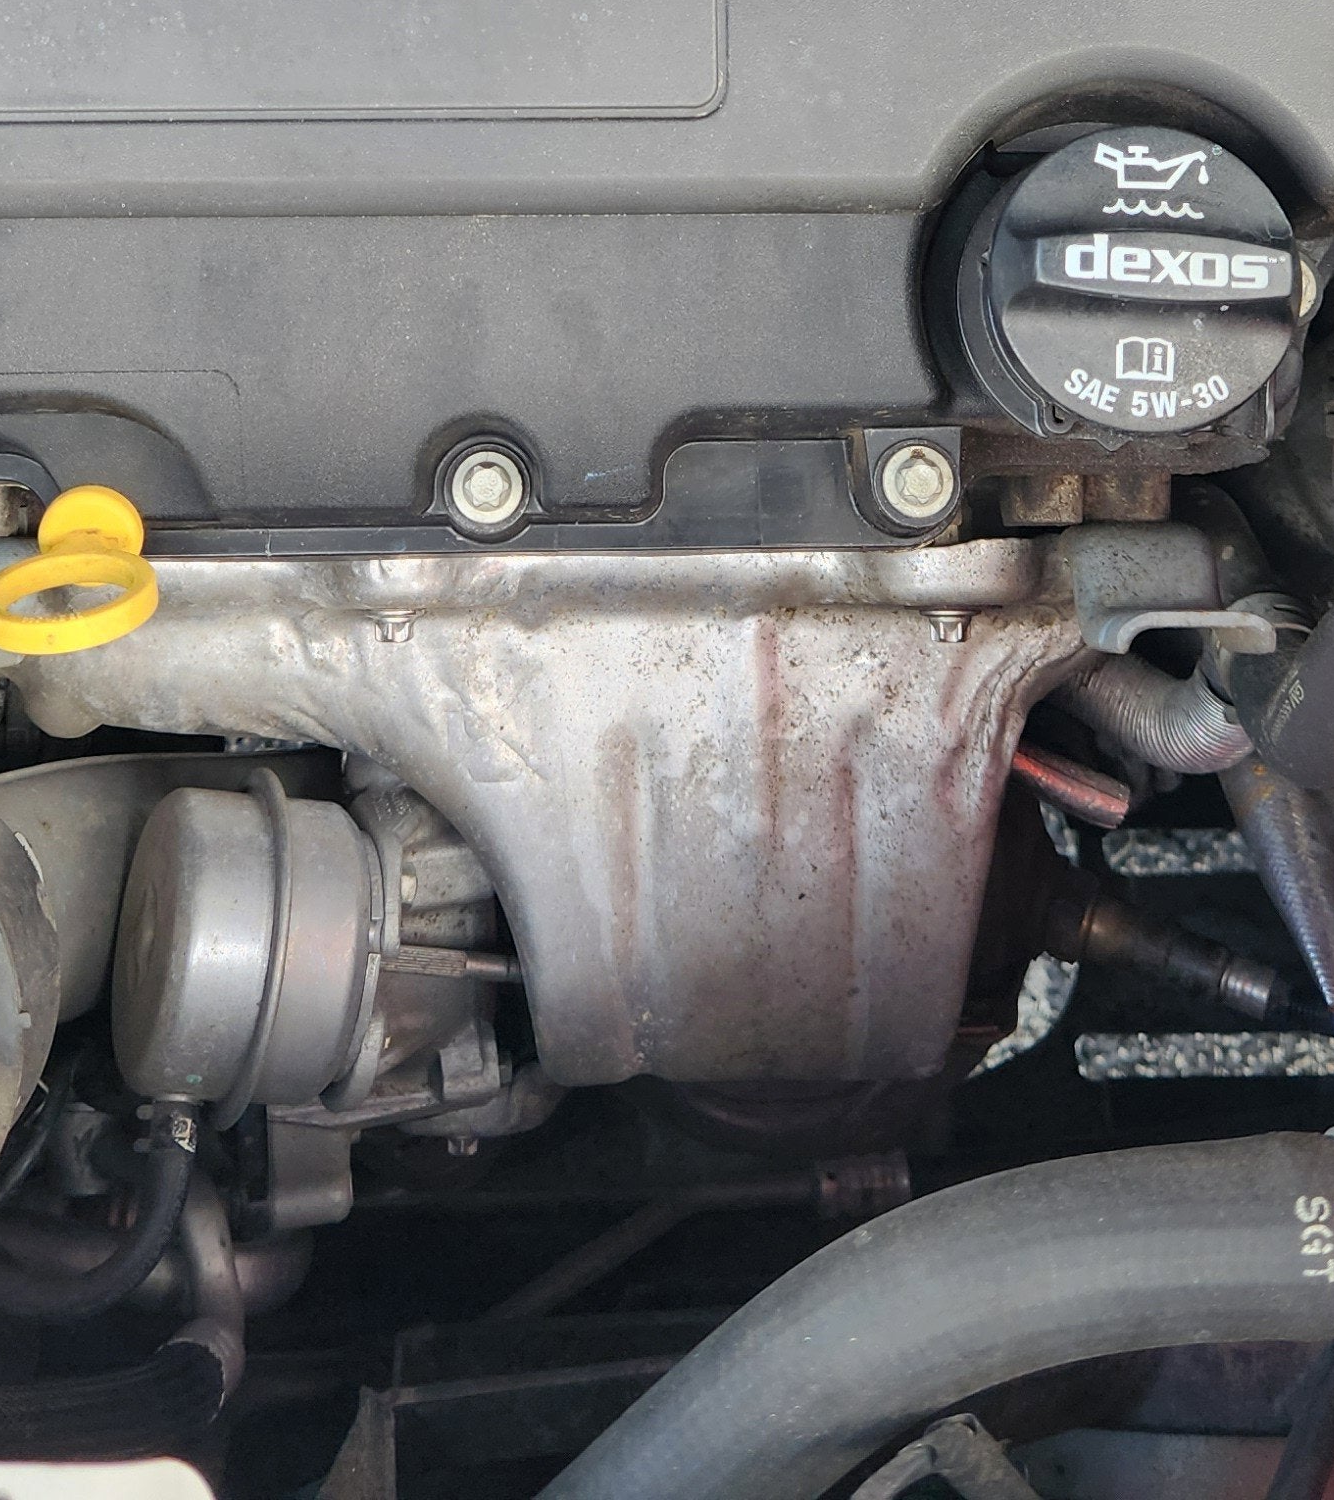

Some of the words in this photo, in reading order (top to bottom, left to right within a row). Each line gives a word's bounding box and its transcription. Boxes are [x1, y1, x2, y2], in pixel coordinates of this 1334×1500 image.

[1064, 234, 1269, 289] dexos
[1064, 368, 1120, 412] SAE
[1131, 375, 1229, 419] 5W-30
